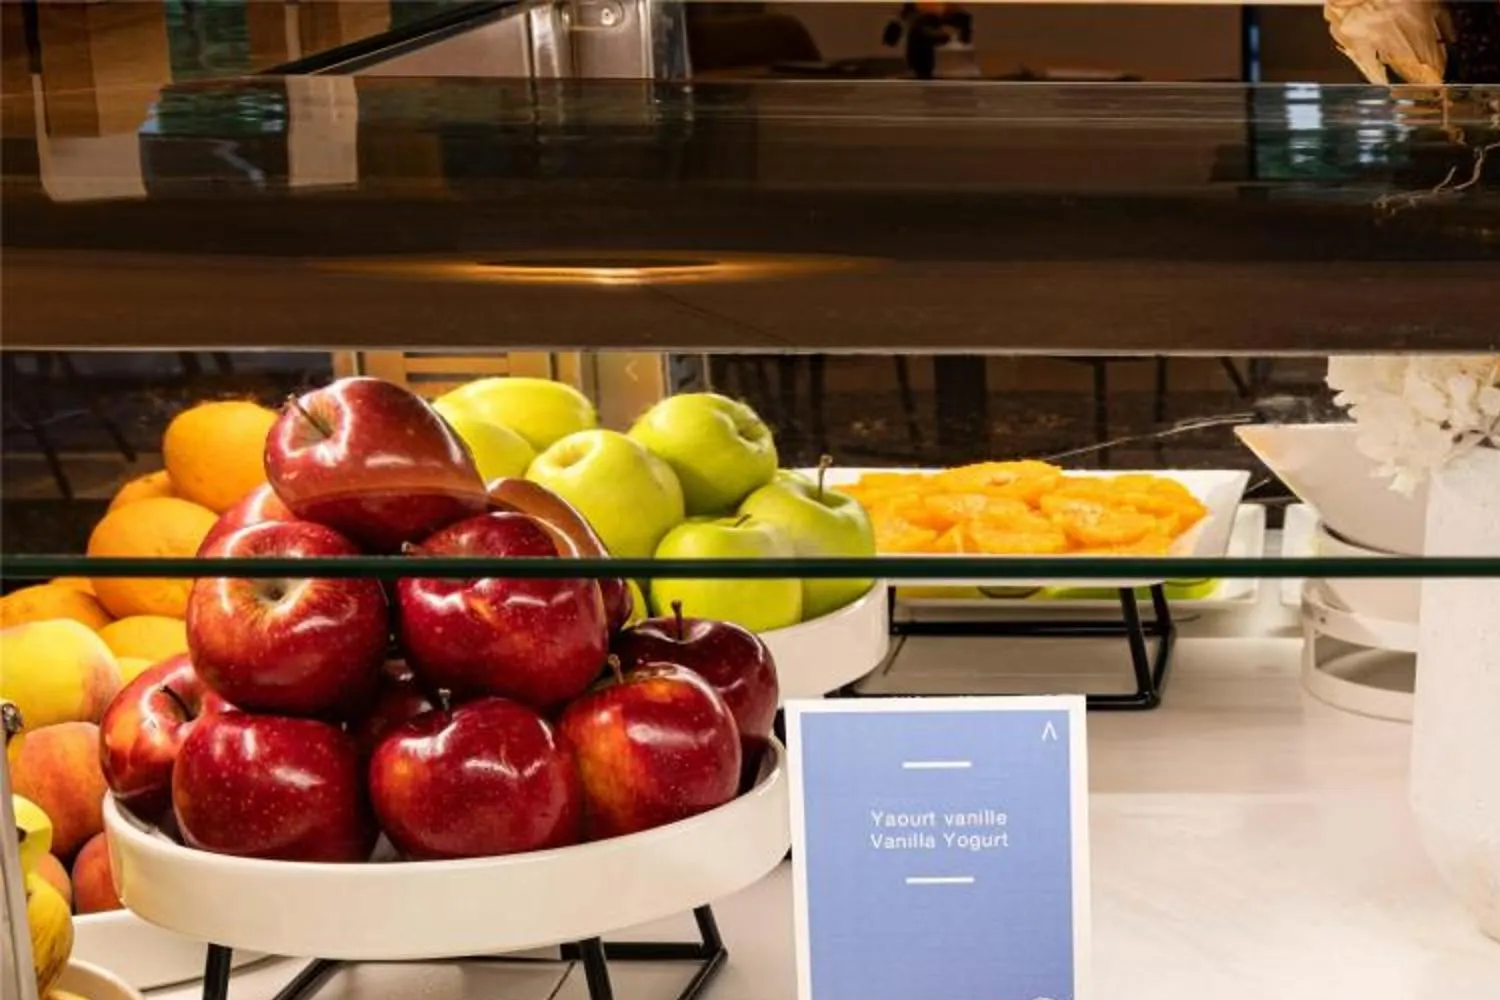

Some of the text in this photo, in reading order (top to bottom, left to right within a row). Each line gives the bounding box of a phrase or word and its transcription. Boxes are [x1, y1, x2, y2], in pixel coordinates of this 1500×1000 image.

[870, 809, 1008, 827] Yaourt vanille
[870, 832, 1009, 851] Vanilla Yogurt
